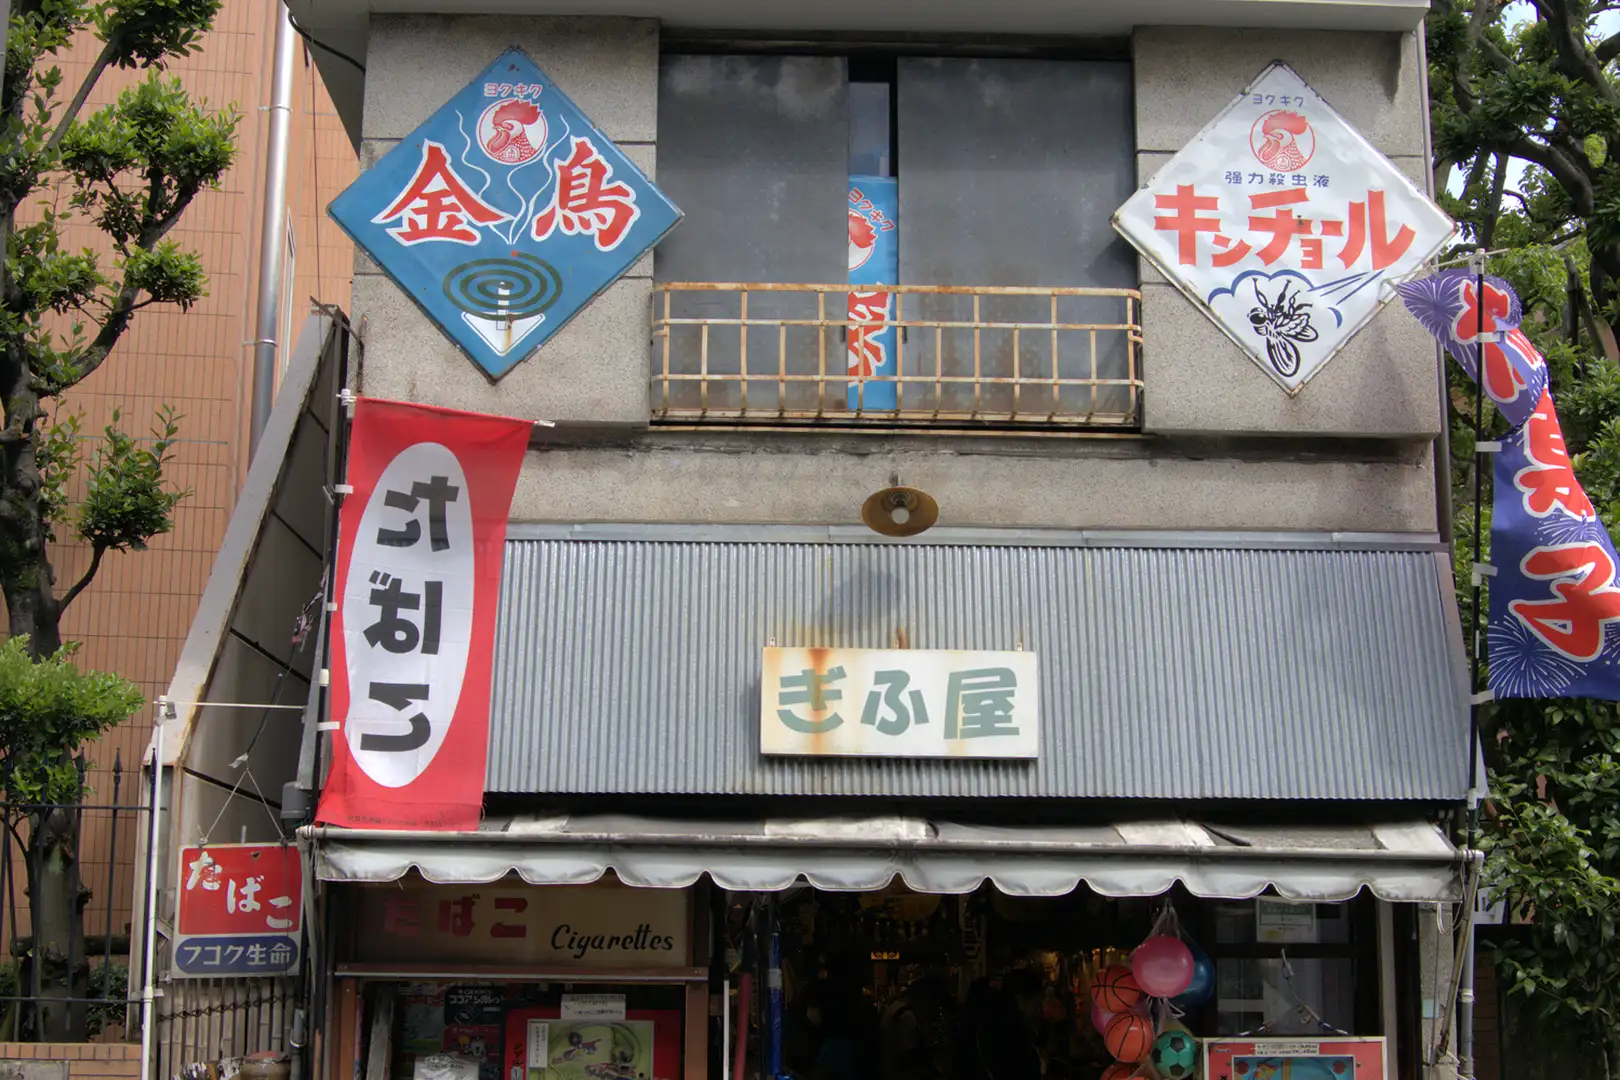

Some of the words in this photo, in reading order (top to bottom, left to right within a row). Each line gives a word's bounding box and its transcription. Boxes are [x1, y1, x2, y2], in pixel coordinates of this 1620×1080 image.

[483, 82, 543, 98] ヨクキク
[1252, 93, 1304, 108] ヨクキク
[371, 136, 641, 252] 金鳥
[848, 186, 896, 232] ヨクキク
[1154, 183, 1417, 272] キンチョール
[776, 665, 1020, 740] ぎふ屋
[186, 851, 293, 929] たばこ
[382, 892, 529, 938] たばこ
[183, 943, 292, 966] フコク生命
[551, 923, 674, 959] Cigarettes
